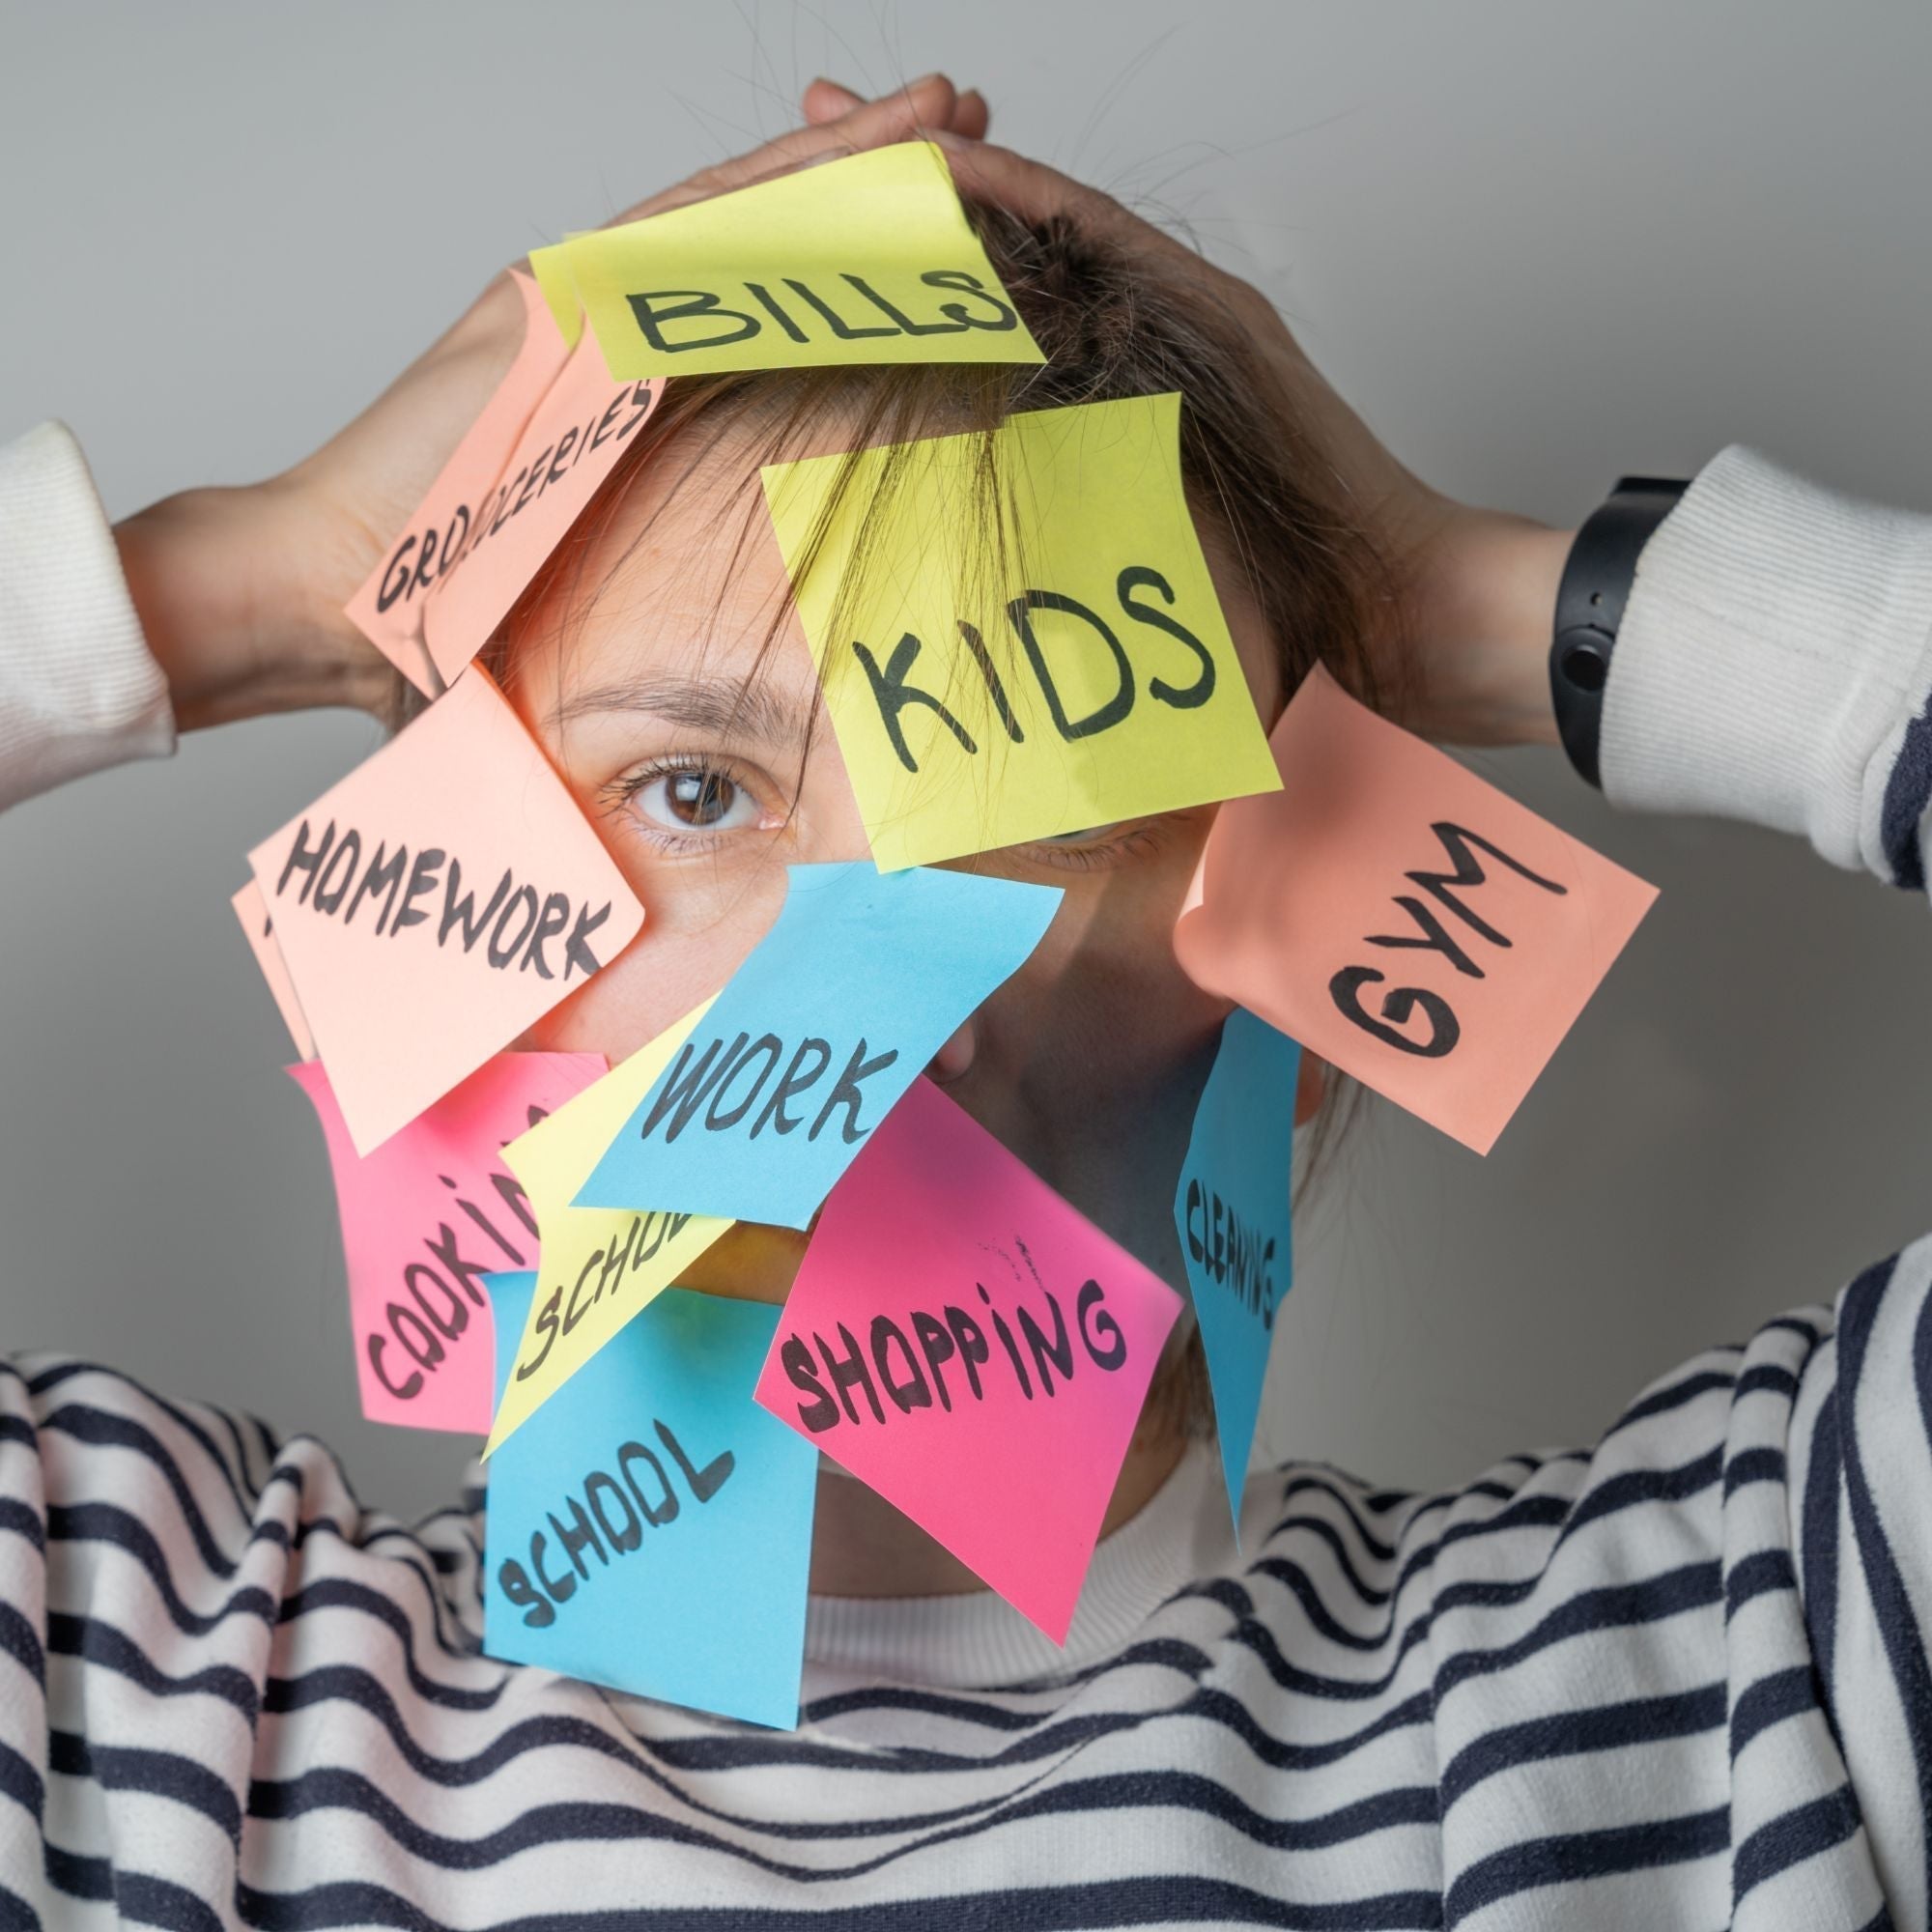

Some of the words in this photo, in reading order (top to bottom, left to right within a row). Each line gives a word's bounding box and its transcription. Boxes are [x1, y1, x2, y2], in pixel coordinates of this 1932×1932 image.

[626, 270, 1018, 354] BILLS
[852, 566, 1216, 774] KIDS
[276, 818, 612, 981] HOMEWORK
[1328, 821, 1568, 1058] GYM
[641, 1032, 899, 1145] WORK
[497, 1418, 736, 1629] SCHOOL
